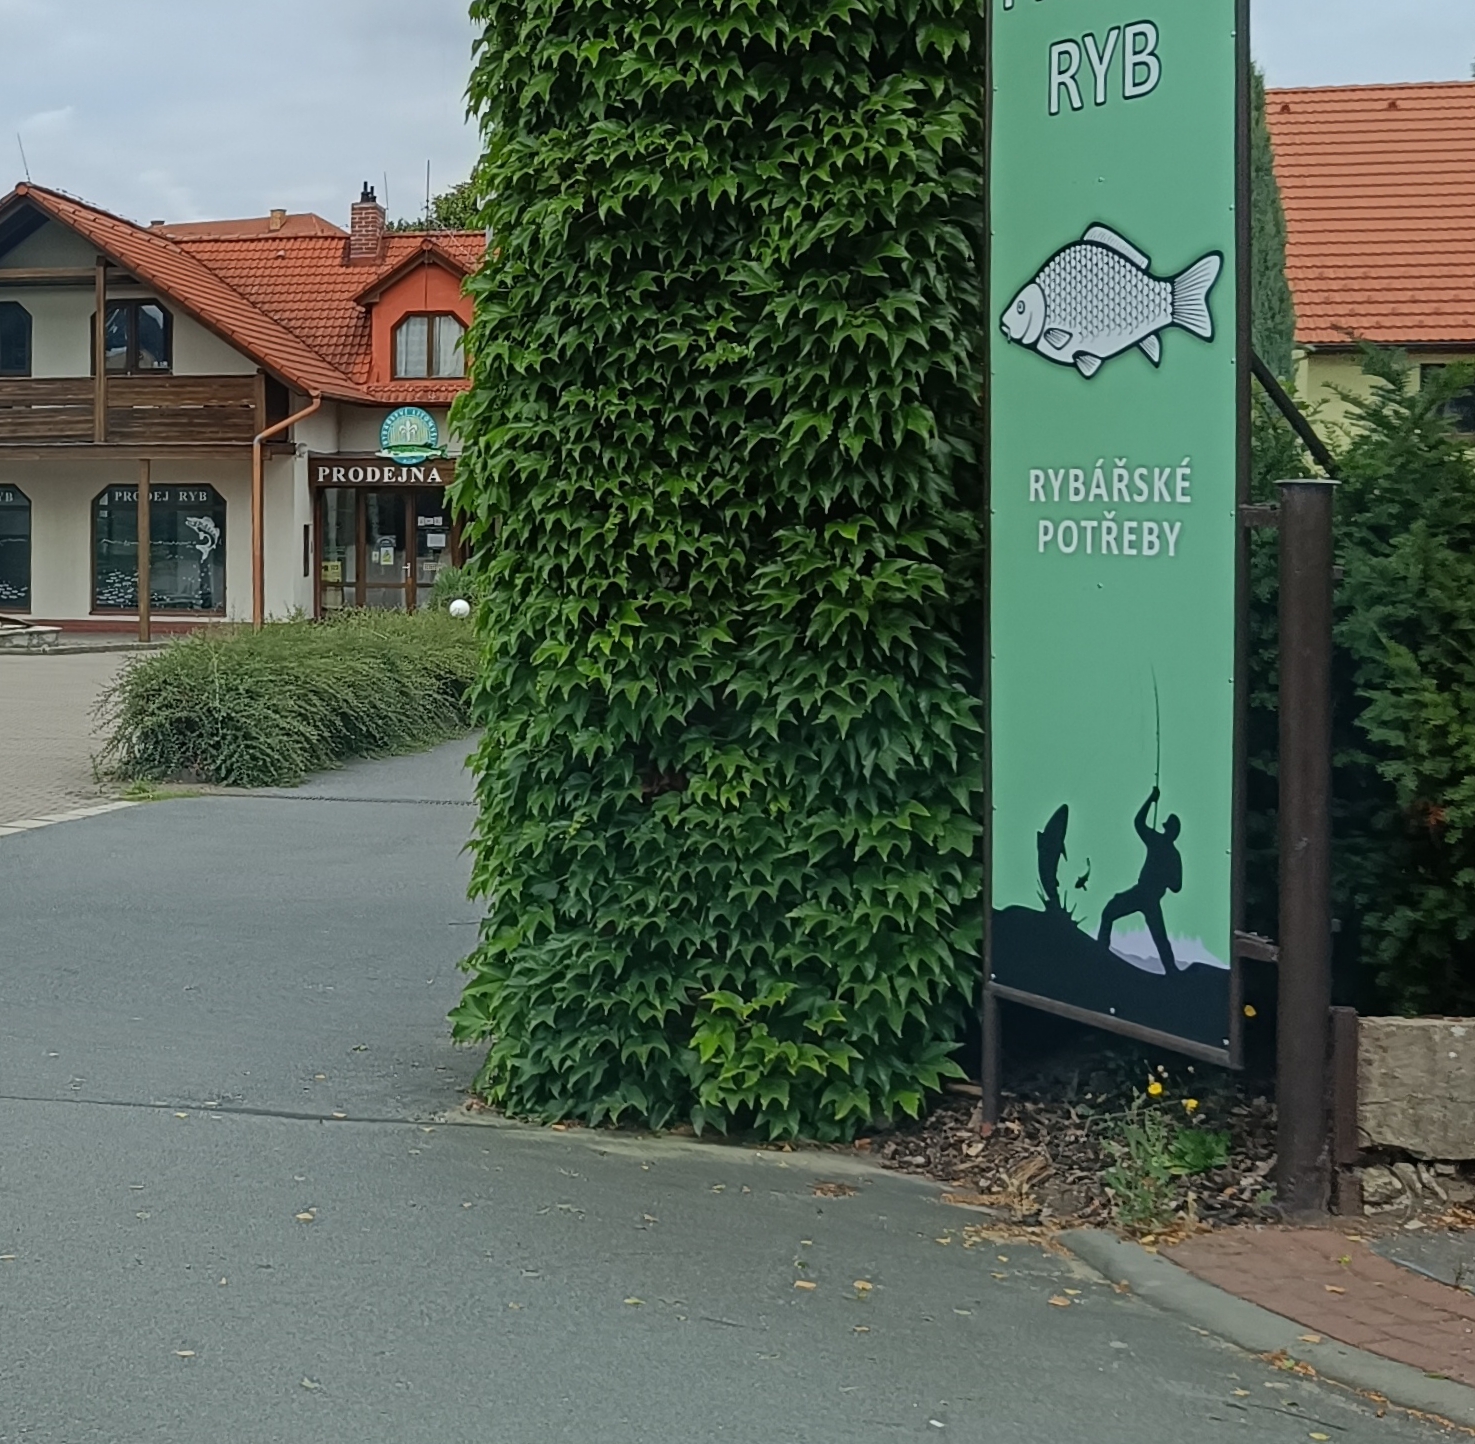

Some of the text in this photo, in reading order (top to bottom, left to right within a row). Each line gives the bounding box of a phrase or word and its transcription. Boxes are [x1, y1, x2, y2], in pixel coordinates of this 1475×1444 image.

[1048, 19, 1162, 116] RYB
[179, 491, 207, 502] RYB
[317, 466, 443, 483] PRODEJNA
[1029, 457, 1191, 503] RYBÁŘSKÉ
[1038, 510, 1182, 557] POTŘEBY
